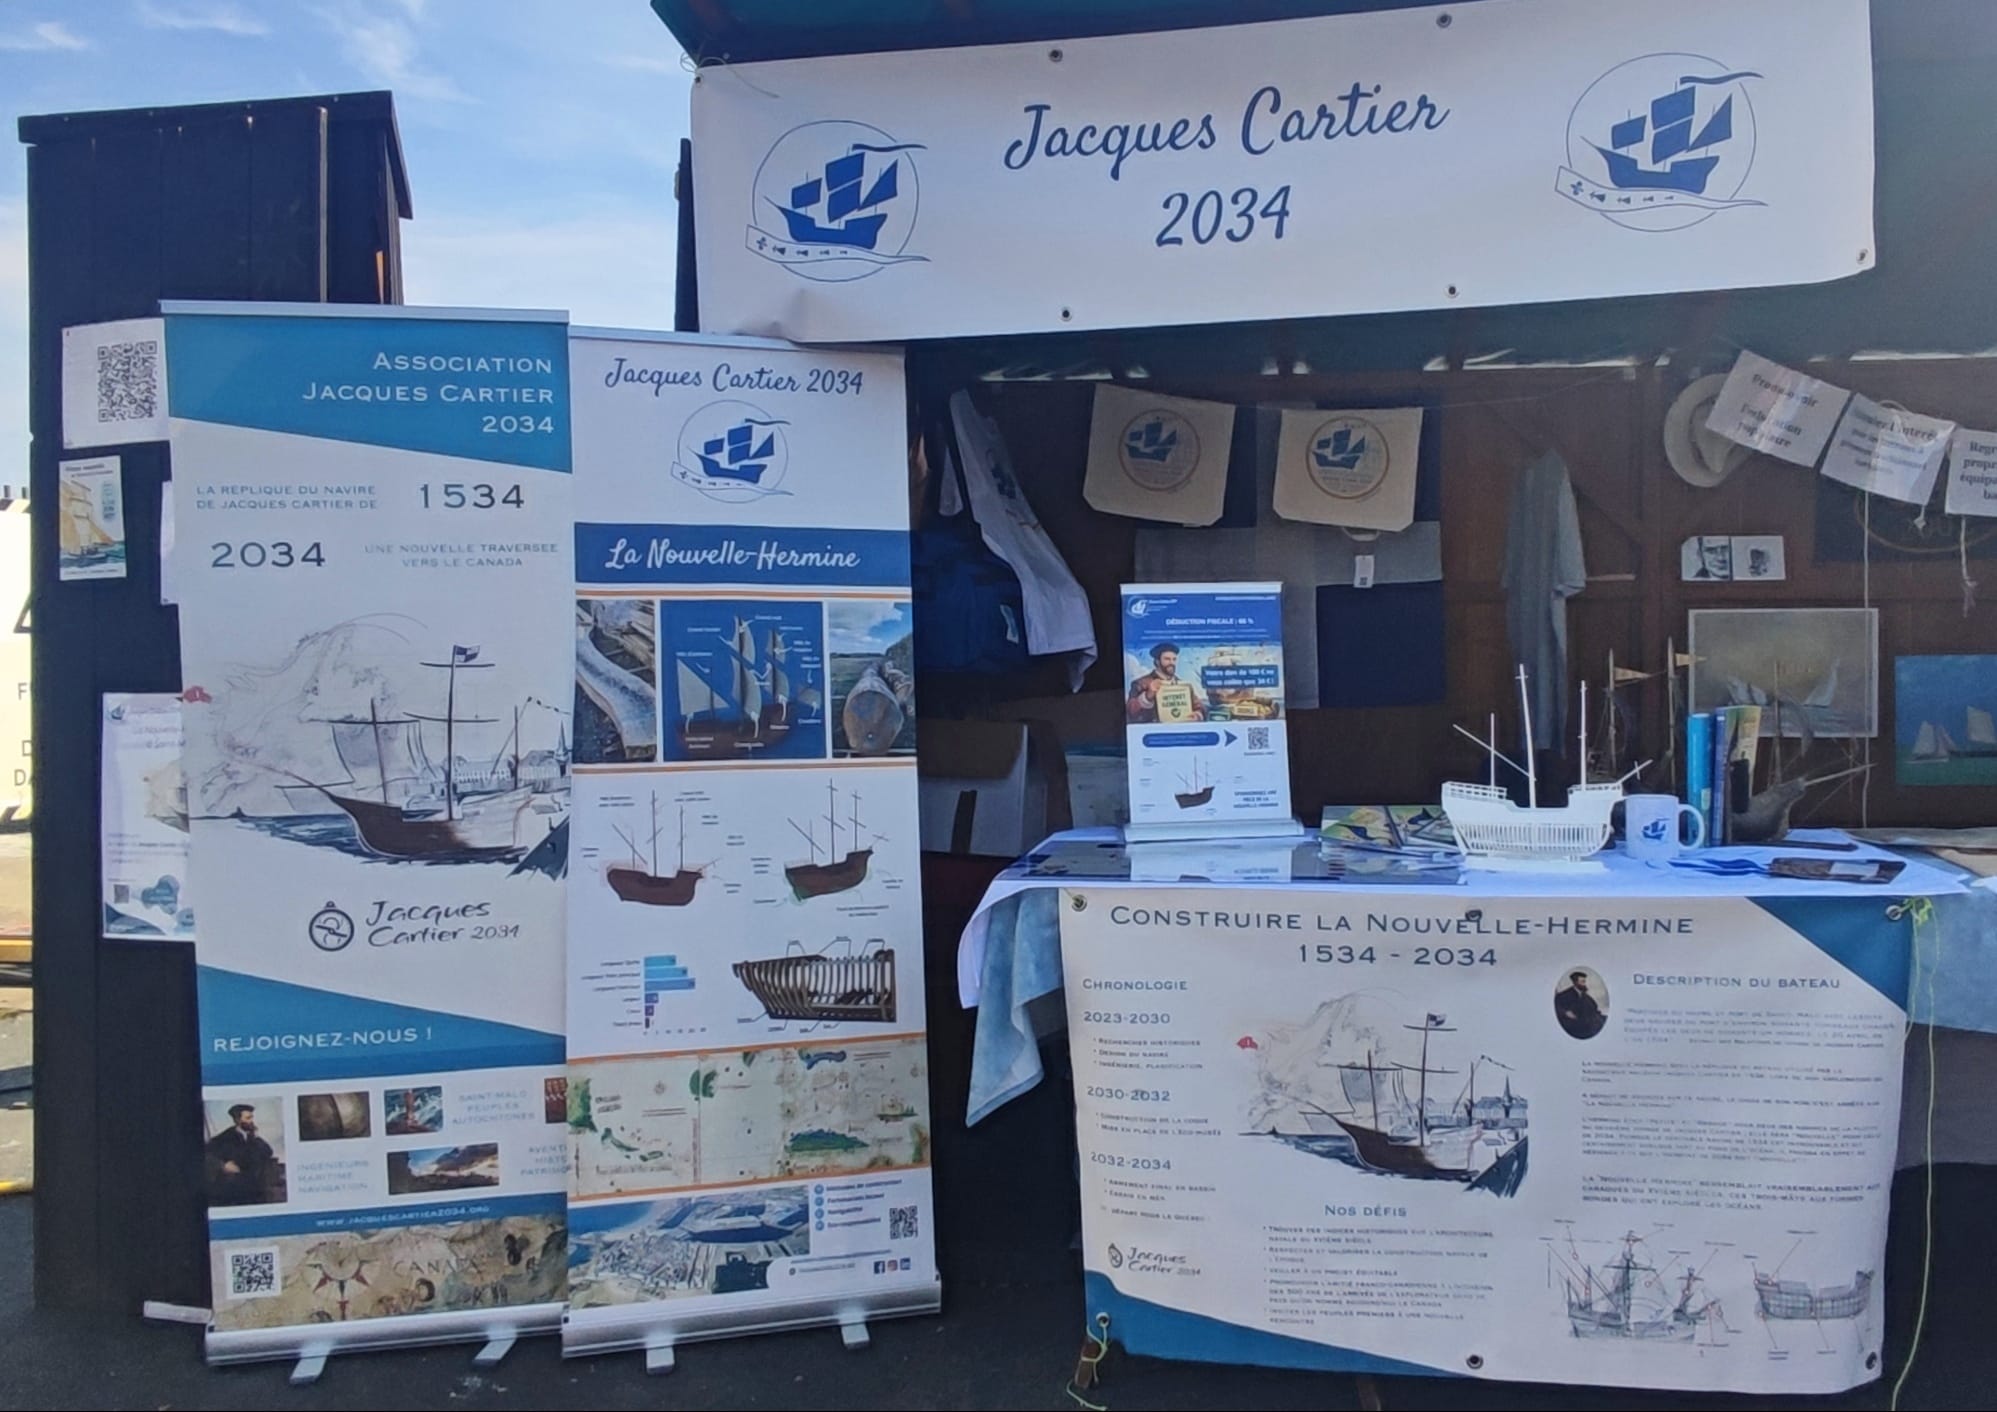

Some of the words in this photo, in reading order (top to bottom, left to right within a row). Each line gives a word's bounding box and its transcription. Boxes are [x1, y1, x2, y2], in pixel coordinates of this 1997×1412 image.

[1004, 101, 1215, 180] Jacques
[1241, 82, 1449, 157] Cartier
[1156, 185, 1290, 246] 2034
[373, 353, 552, 374] ASSOCIATION
[605, 358, 702, 397] Jacques
[712, 363, 801, 393] Cartier
[807, 369, 862, 394] 2034
[302, 382, 428, 403] JACQUES
[440, 384, 554, 405] CARTIER
[482, 416, 554, 434] 2034
[196, 485, 216, 495] LA
[298, 485, 318, 495] DU
[324, 485, 376, 495] NAVIRE
[420, 484, 524, 509] 1534
[196, 500, 215, 510] DE
[220, 500, 287, 510] JACQUES
[291, 500, 353, 510] CARTIER
[359, 500, 377, 510] DE
[211, 542, 325, 567] 2034
[364, 544, 393, 554] UNE
[400, 544, 474, 553] NOUVELLE
[605, 539, 641, 569] La
[647, 540, 860, 569] Nouvelle-Hermine
[402, 558, 439, 568] VERS
[444, 558, 459, 568] LE
[465, 558, 523, 567] CANADA
[366, 900, 491, 926] Jacques
[1110, 905, 1302, 930] CONSTRUIRE
[1317, 914, 1352, 932] LA
[1367, 914, 1694, 935] NOUVELLE-HERMINE
[367, 926, 461, 947] Cartier
[470, 924, 521, 941] 2034
[1299, 944, 1376, 964] 1534
[1414, 948, 1498, 967] 2034
[1083, 978, 1188, 990] CHRONOLOGIE
[1633, 974, 1741, 988] DESCRIPTION
[1750, 977, 1771, 988] DU
[1778, 977, 1840, 989] BATEAU
[1083, 1011, 1171, 1024] 2023-2030
[213, 1026, 418, 1053] REJOIGNEZ-NOUS
[1087, 1086, 1171, 1101] 2030-2032
[1091, 1151, 1171, 1170] 2032-2034
[1324, 1204, 1356, 1217] NOS
[1363, 1204, 1407, 1217] DÉFIS
[1127, 1247, 1186, 1264] Jacques
